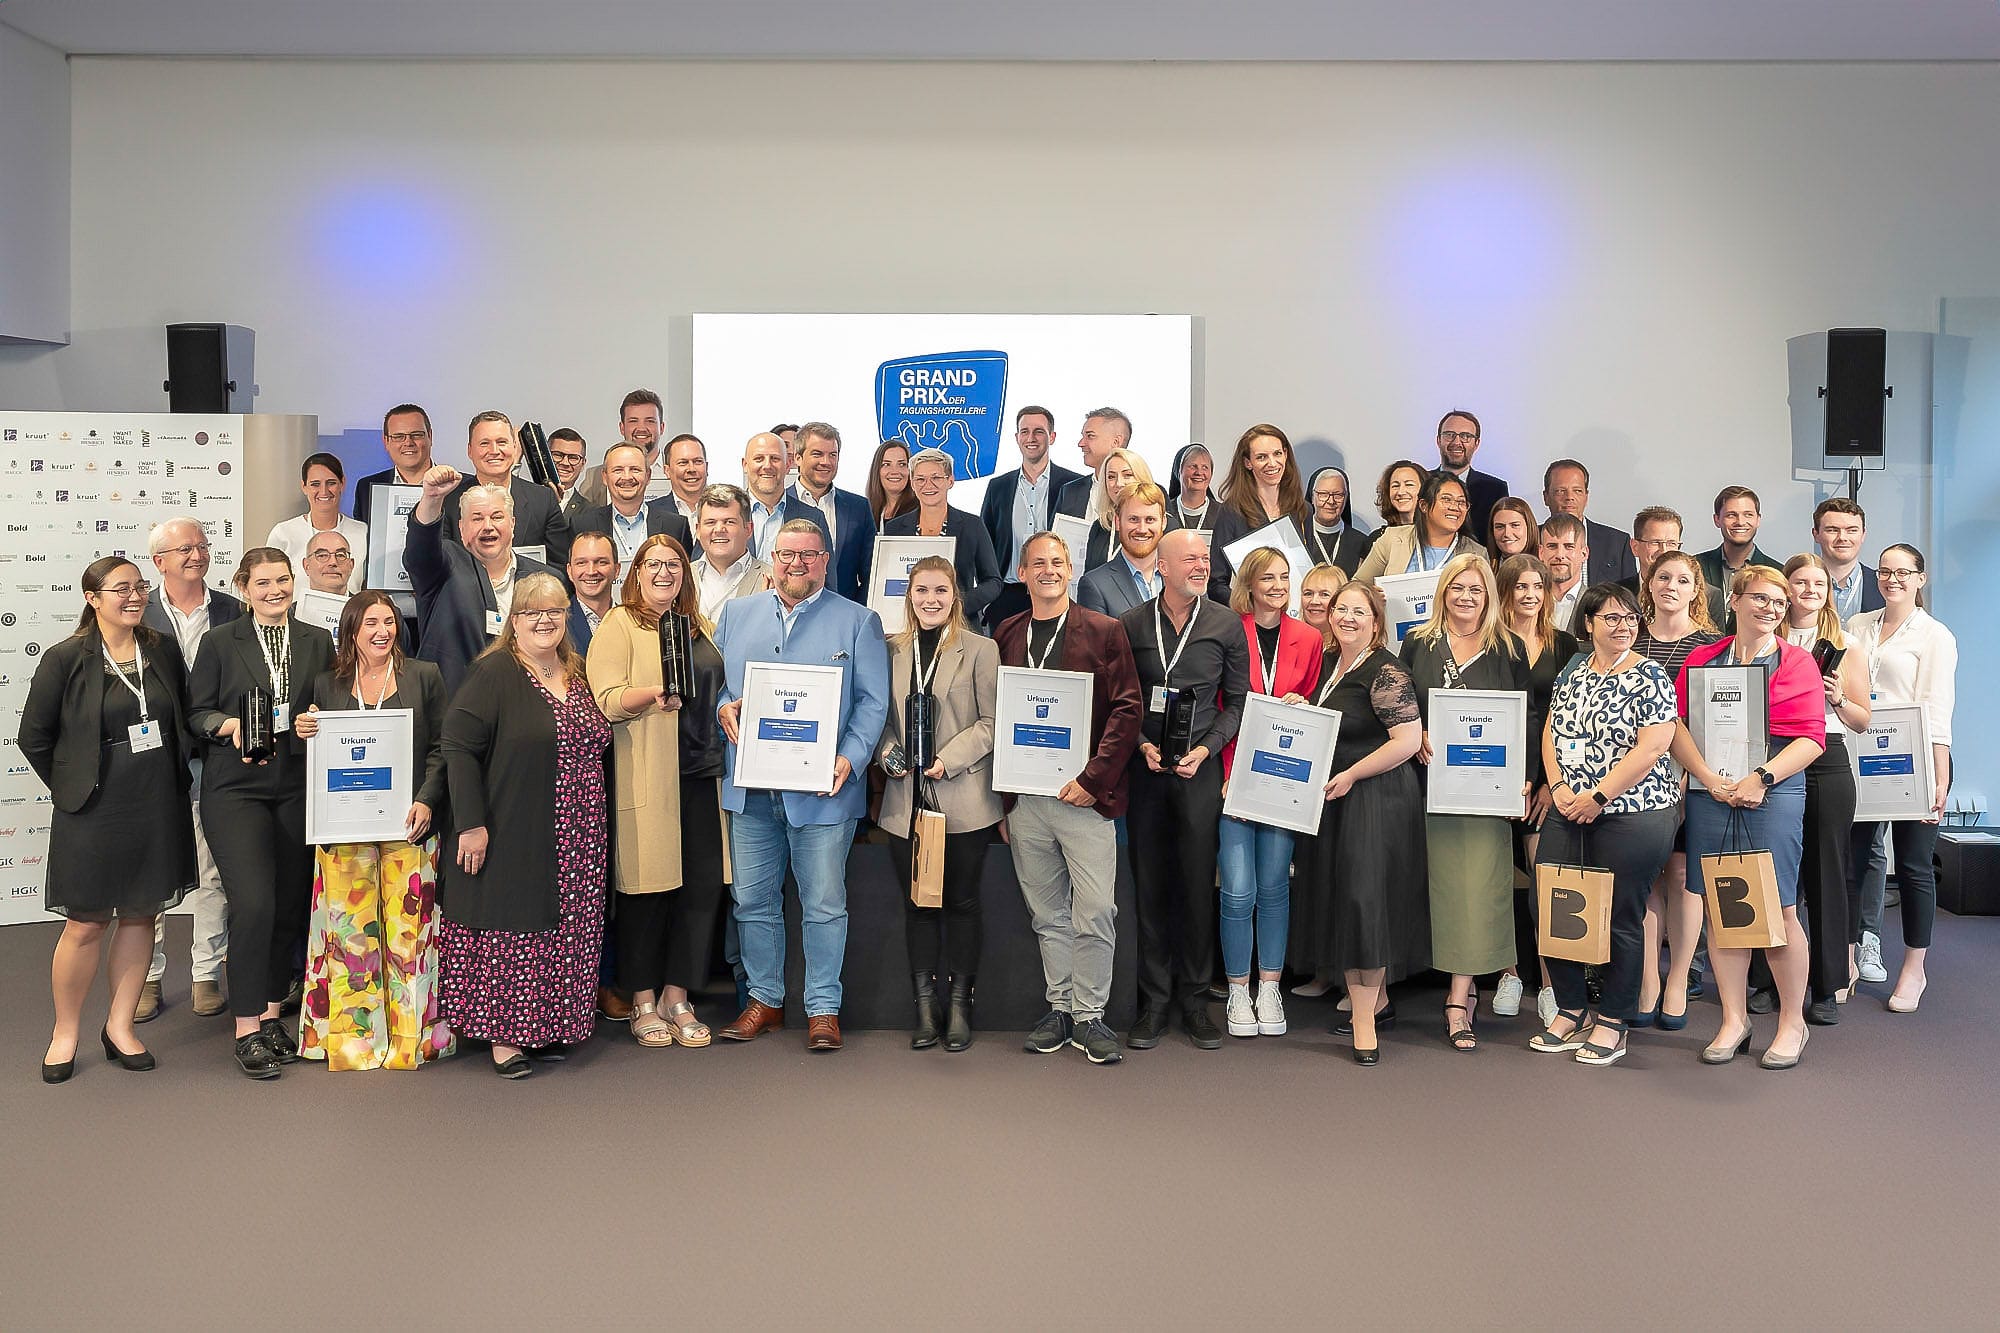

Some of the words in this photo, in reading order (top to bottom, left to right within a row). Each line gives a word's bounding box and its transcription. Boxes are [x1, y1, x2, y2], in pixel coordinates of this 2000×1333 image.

[900, 369, 977, 386] GRAND
[900, 387, 949, 405] PRIX
[948, 396, 966, 405] DER
[899, 406, 987, 415] TAGUNGSHOTELLERIE
[7, 524, 28, 532] Bold
[25, 554, 46, 562] Bold
[51, 584, 72, 592] Bold
[1405, 594, 1434, 603] Urkunde
[774, 689, 808, 698] Urkunde
[1716, 692, 1740, 701] RAUM
[1027, 694, 1059, 704] Urkunde
[1459, 715, 1493, 723] Urkunde
[1271, 722, 1304, 736] Urkunde
[1867, 727, 1898, 735] Urkunde
[340, 736, 377, 745] Urkunde
[11, 886, 38, 895] HGK
